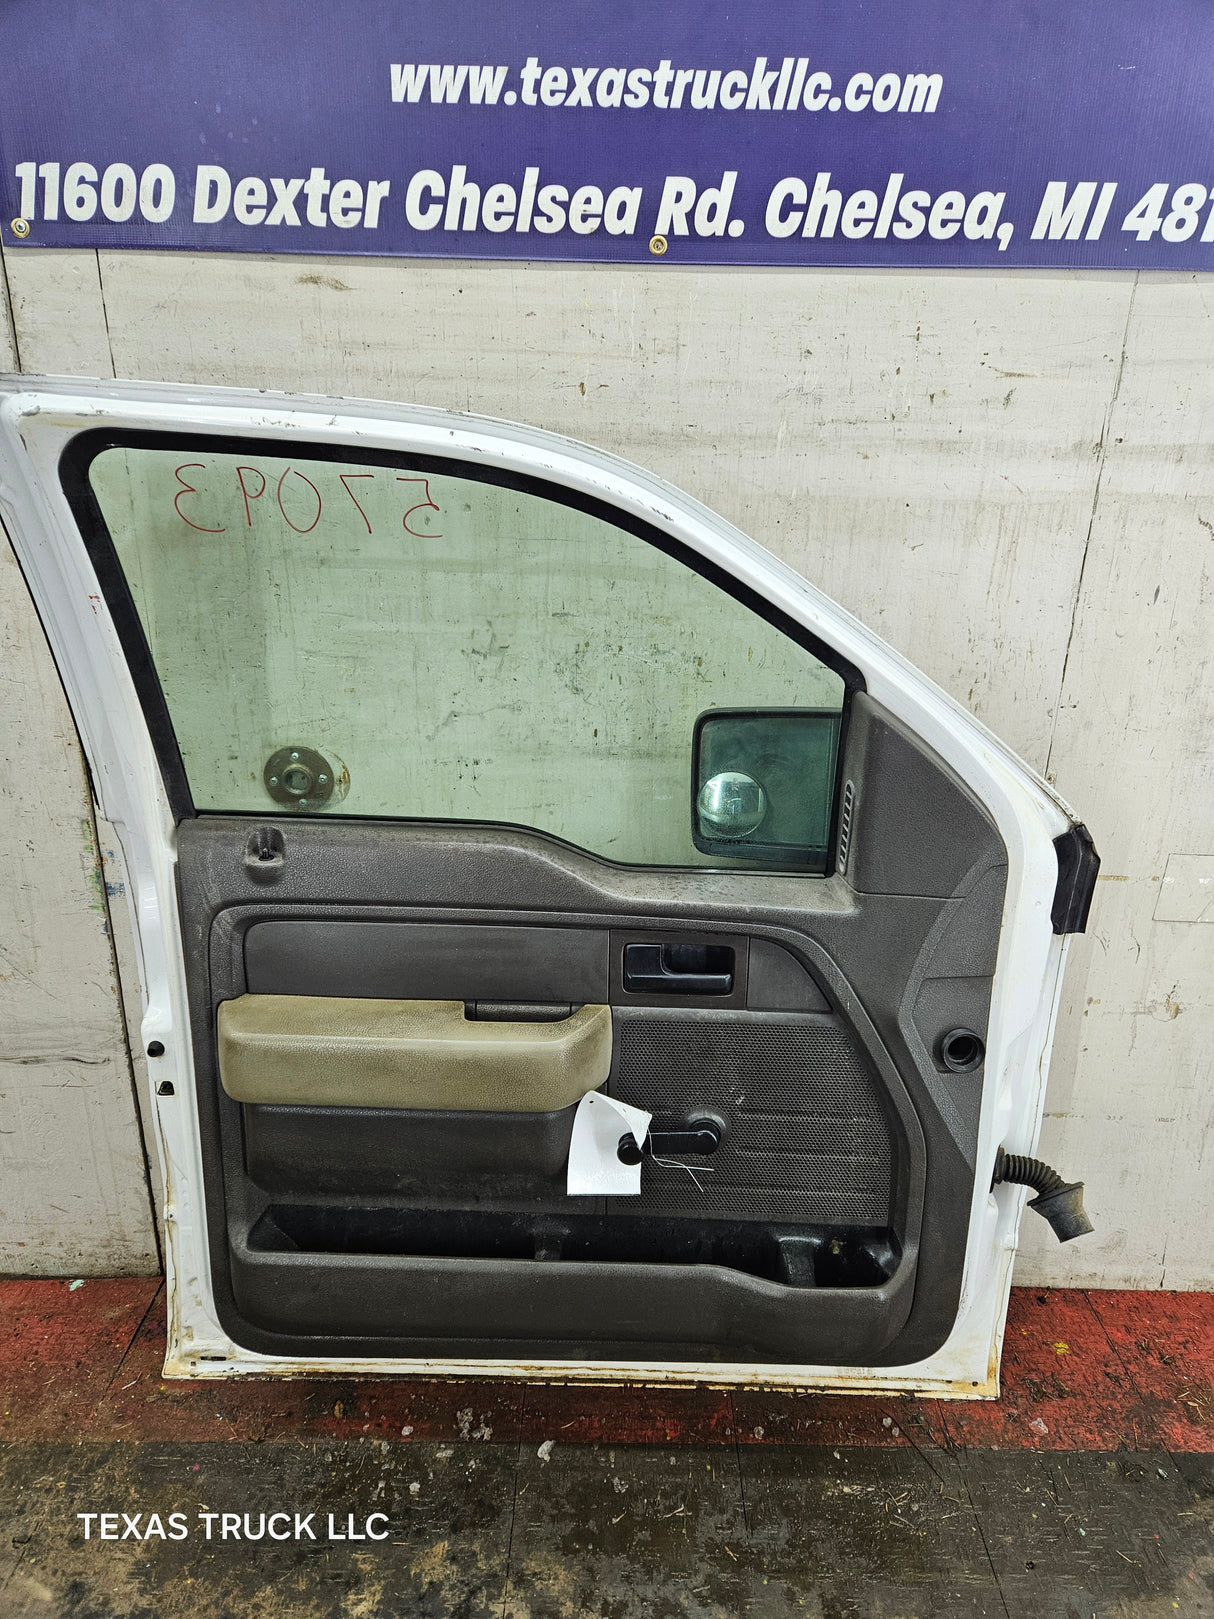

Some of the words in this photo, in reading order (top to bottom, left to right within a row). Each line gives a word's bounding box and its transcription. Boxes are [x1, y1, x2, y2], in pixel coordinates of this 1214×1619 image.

[390, 57, 944, 113] www.texastruckllc.com
[15, 162, 176, 224] 11600
[193, 164, 391, 229] Dexter
[405, 165, 643, 235] Chelsea
[655, 170, 745, 238] Rd.
[765, 172, 1014, 251] Chelsea,
[1030, 181, 1119, 241] MI
